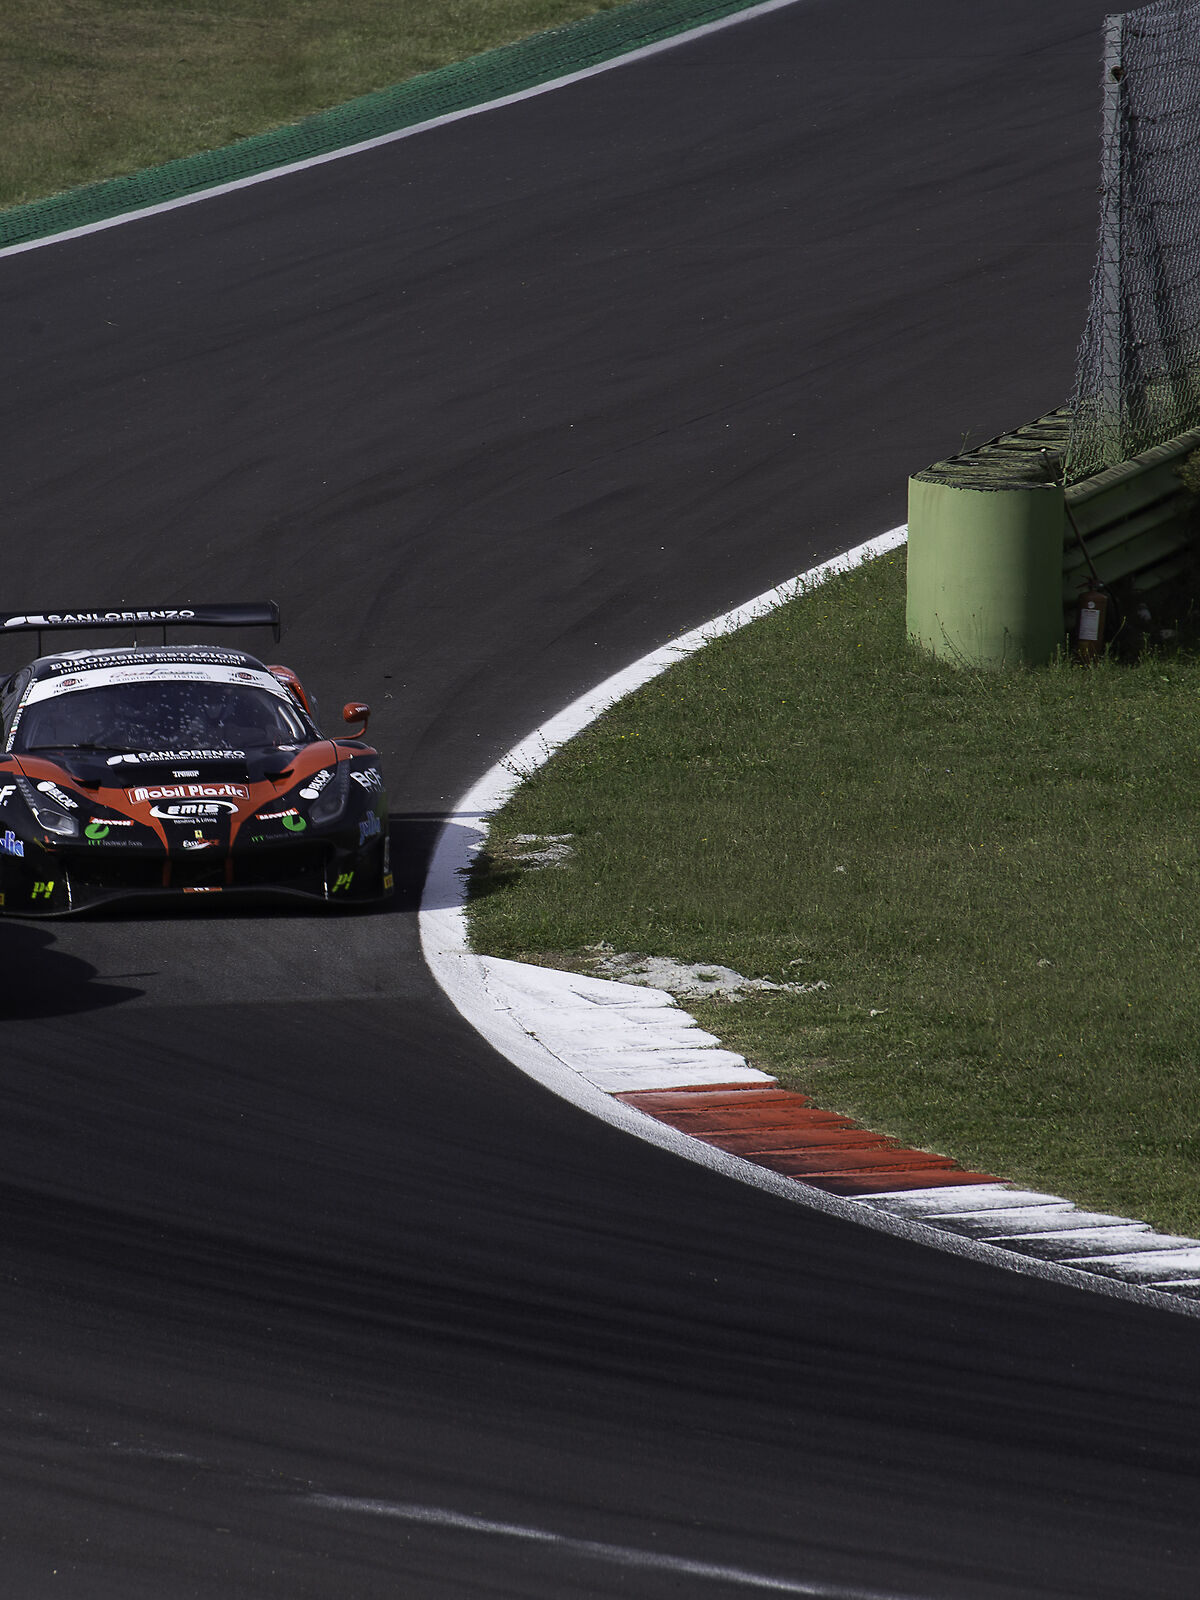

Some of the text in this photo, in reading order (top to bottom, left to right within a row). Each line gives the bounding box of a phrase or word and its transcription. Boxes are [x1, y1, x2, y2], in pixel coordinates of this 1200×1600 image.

[48, 609, 195, 622] SANLORENZO
[50, 651, 248, 671] EURODISINFESTAZIONI
[138, 749, 246, 759] SANLORENZO
[134, 784, 245, 802] Mobil Plastic
